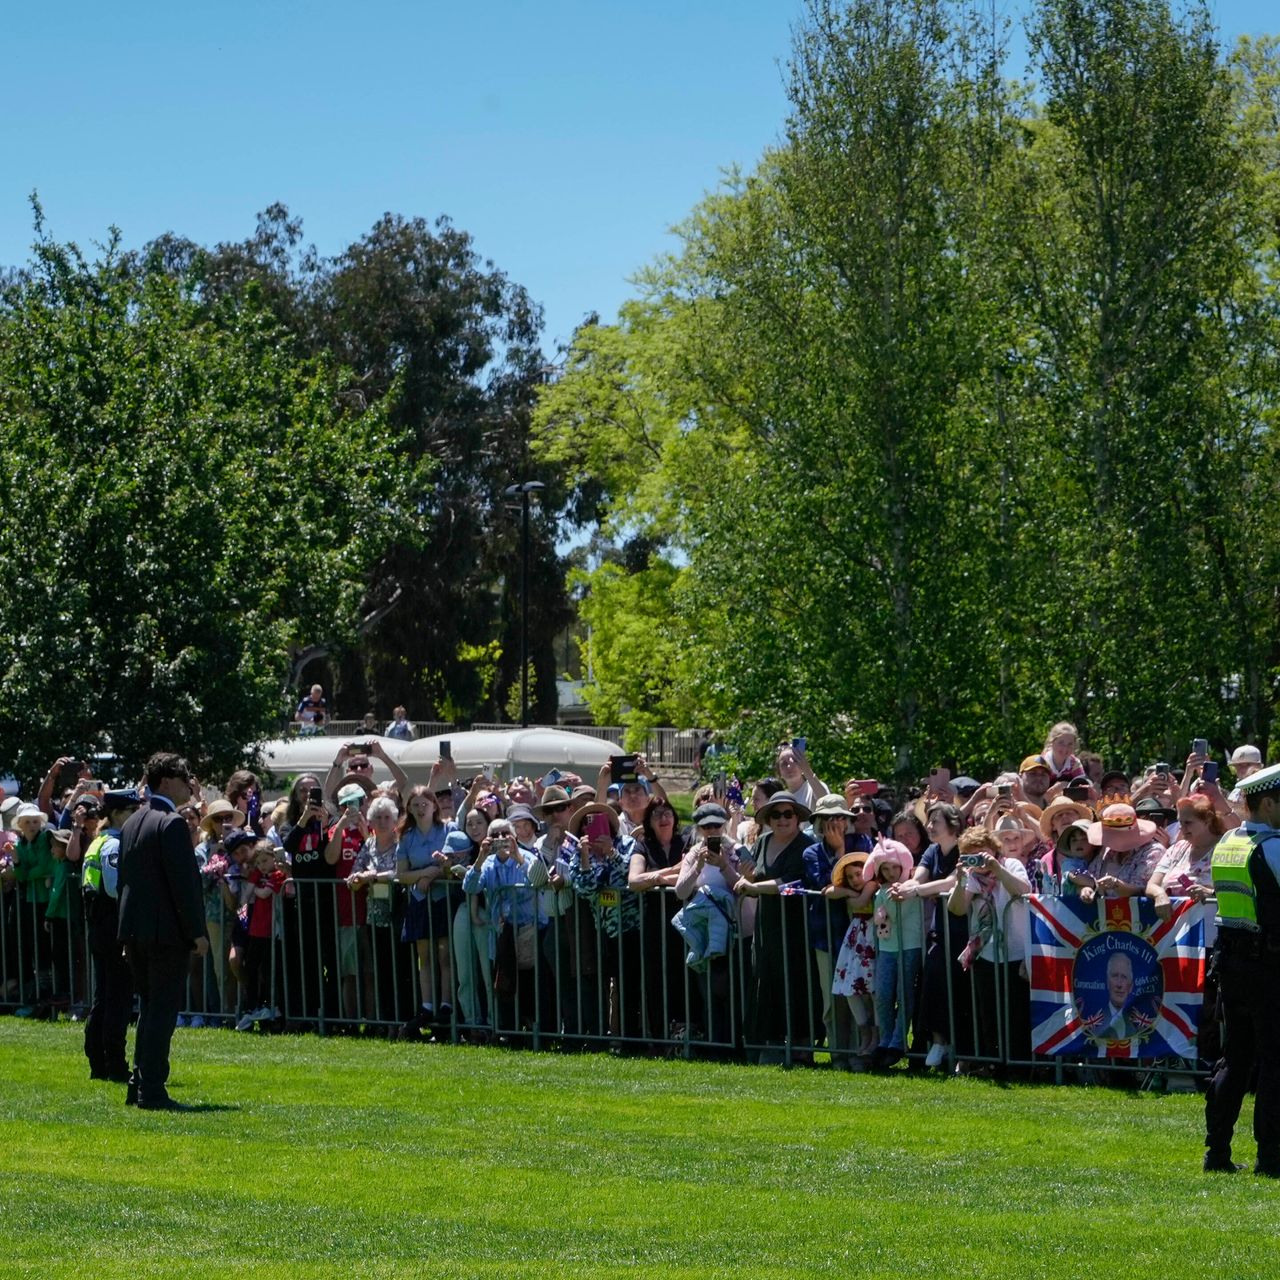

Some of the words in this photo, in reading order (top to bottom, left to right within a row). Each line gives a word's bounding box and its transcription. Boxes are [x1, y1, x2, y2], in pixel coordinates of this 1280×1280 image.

[1214, 853, 1247, 864] POLICE
[1082, 943, 1106, 961] King
[1106, 935, 1140, 955] Charles
[1141, 949, 1154, 964] III
[1074, 978, 1106, 990] Coronation
